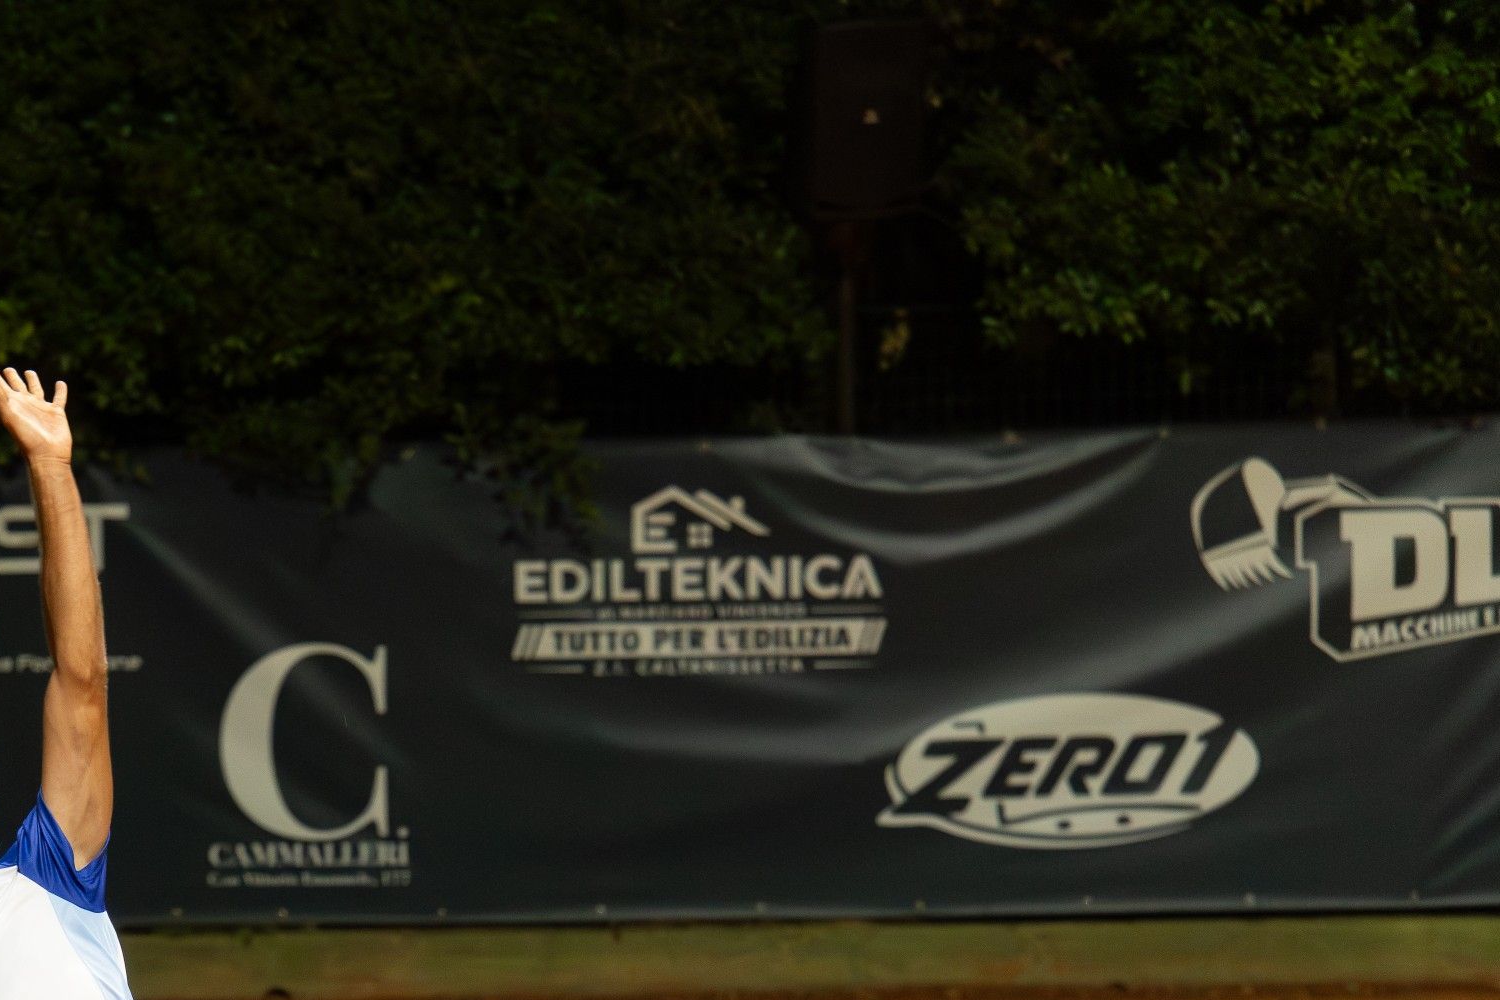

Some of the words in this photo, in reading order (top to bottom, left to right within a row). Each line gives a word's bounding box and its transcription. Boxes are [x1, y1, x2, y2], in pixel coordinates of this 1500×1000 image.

[513, 553, 883, 604] EDILTEKNICA
[553, 629, 640, 652] TUTTO
[653, 628, 705, 650] PER
[717, 625, 850, 649] L'EDILIZIA
[219, 641, 389, 840] C
